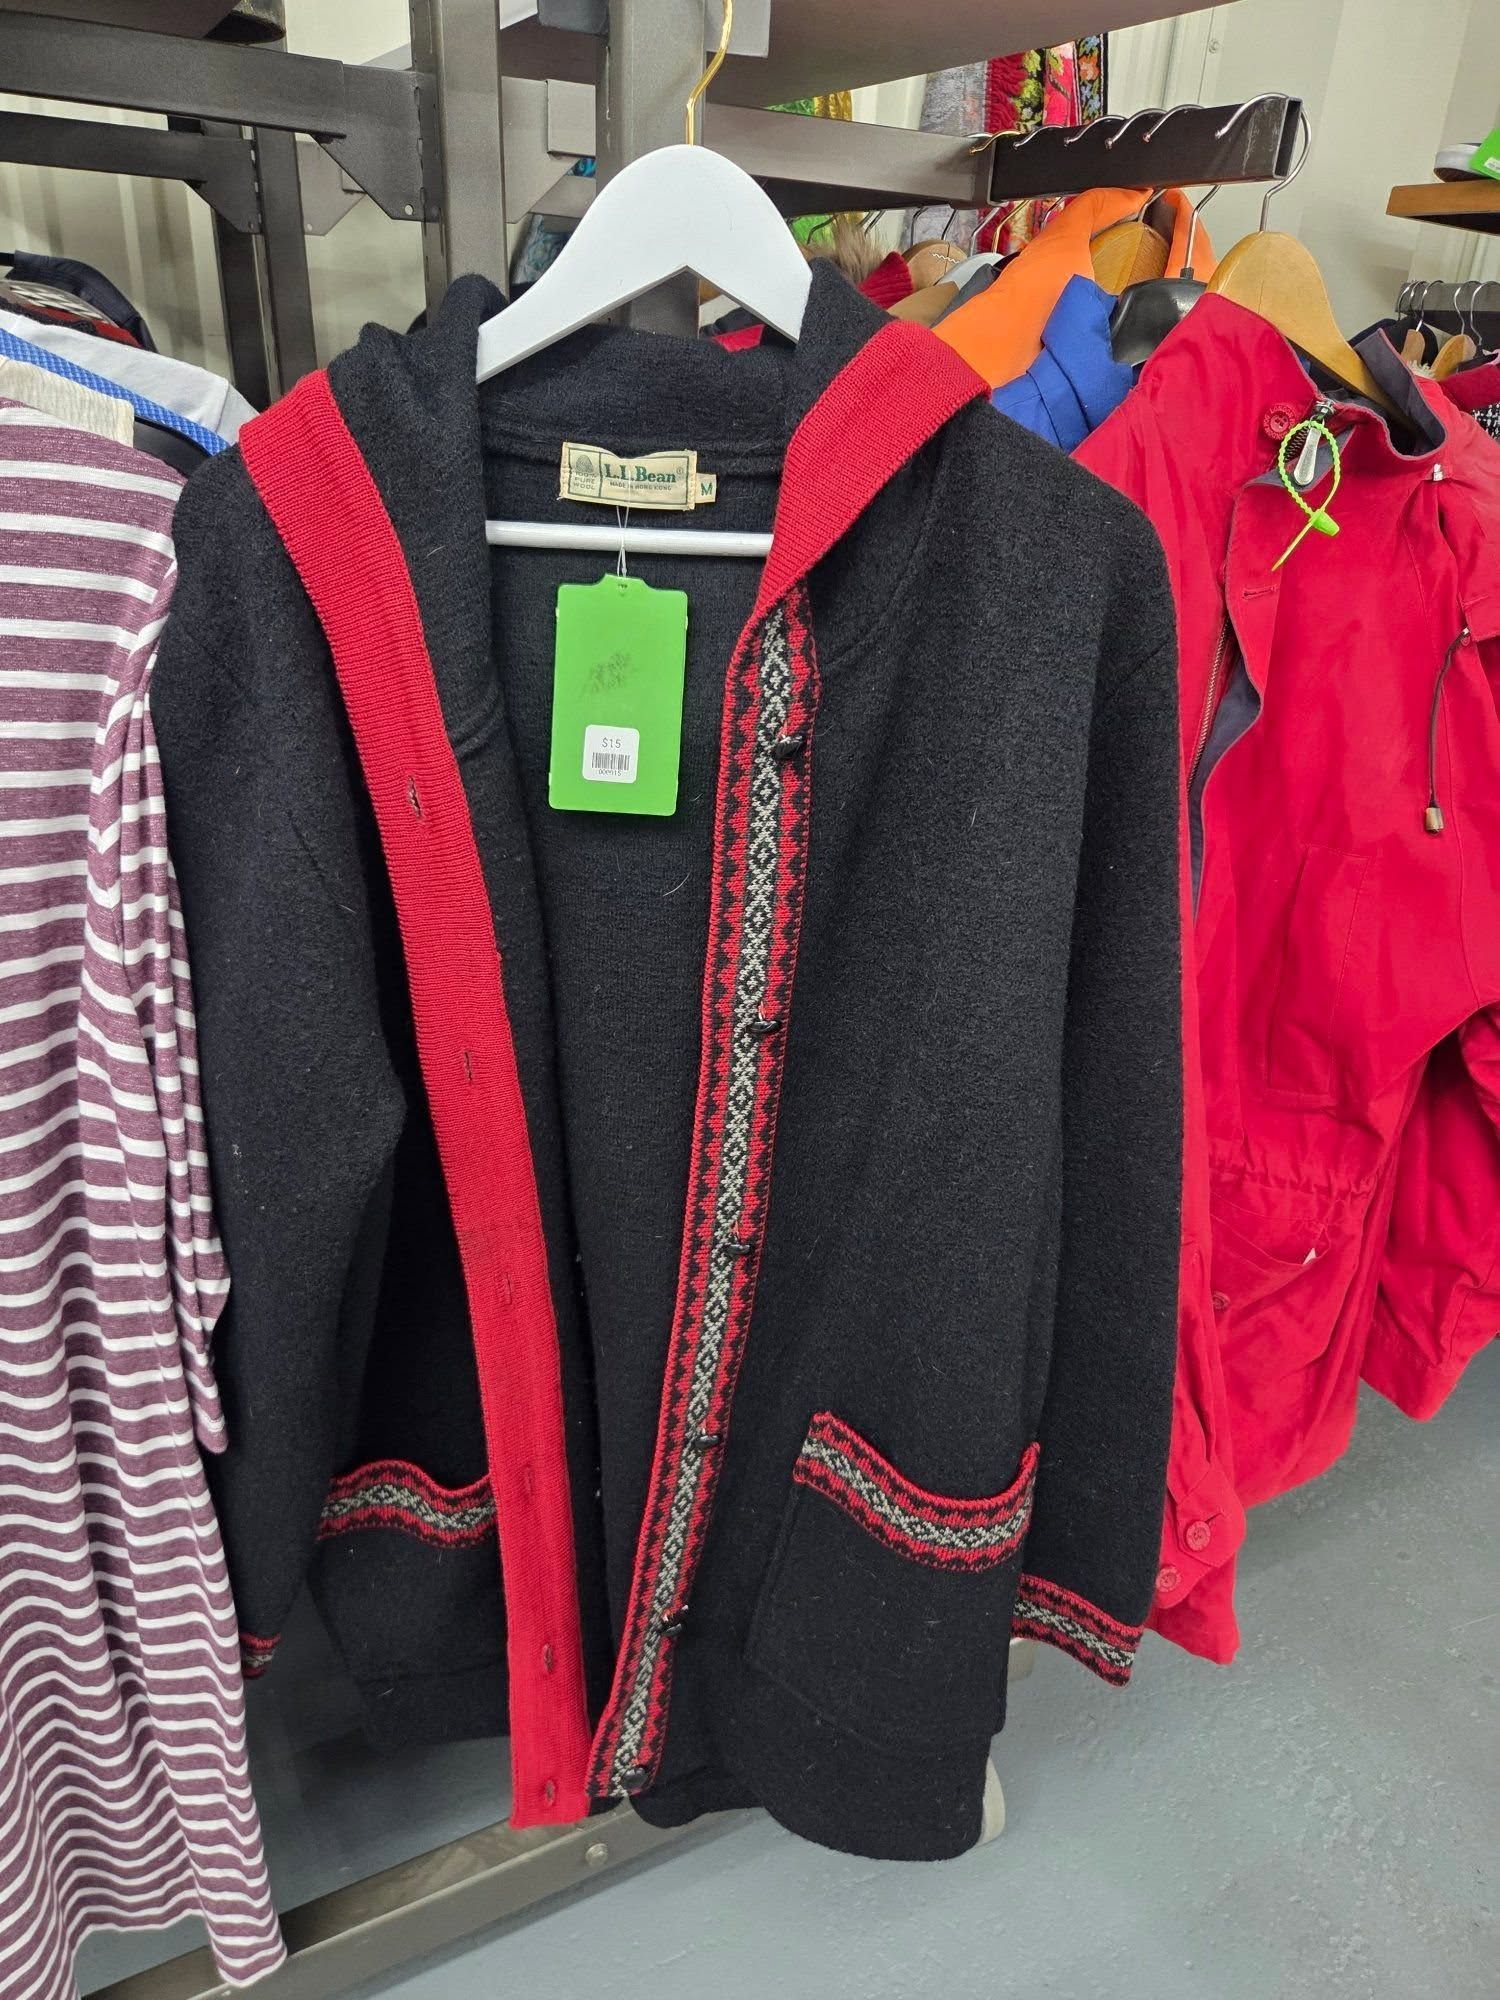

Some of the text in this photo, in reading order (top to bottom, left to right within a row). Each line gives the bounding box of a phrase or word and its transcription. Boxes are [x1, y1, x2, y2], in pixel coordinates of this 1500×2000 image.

[574, 476, 595, 484] PURE
[573, 482, 596, 490] WOOL
[610, 481, 626, 489] MADE
[701, 482, 713, 496] M
[602, 737, 621, 749] $15
